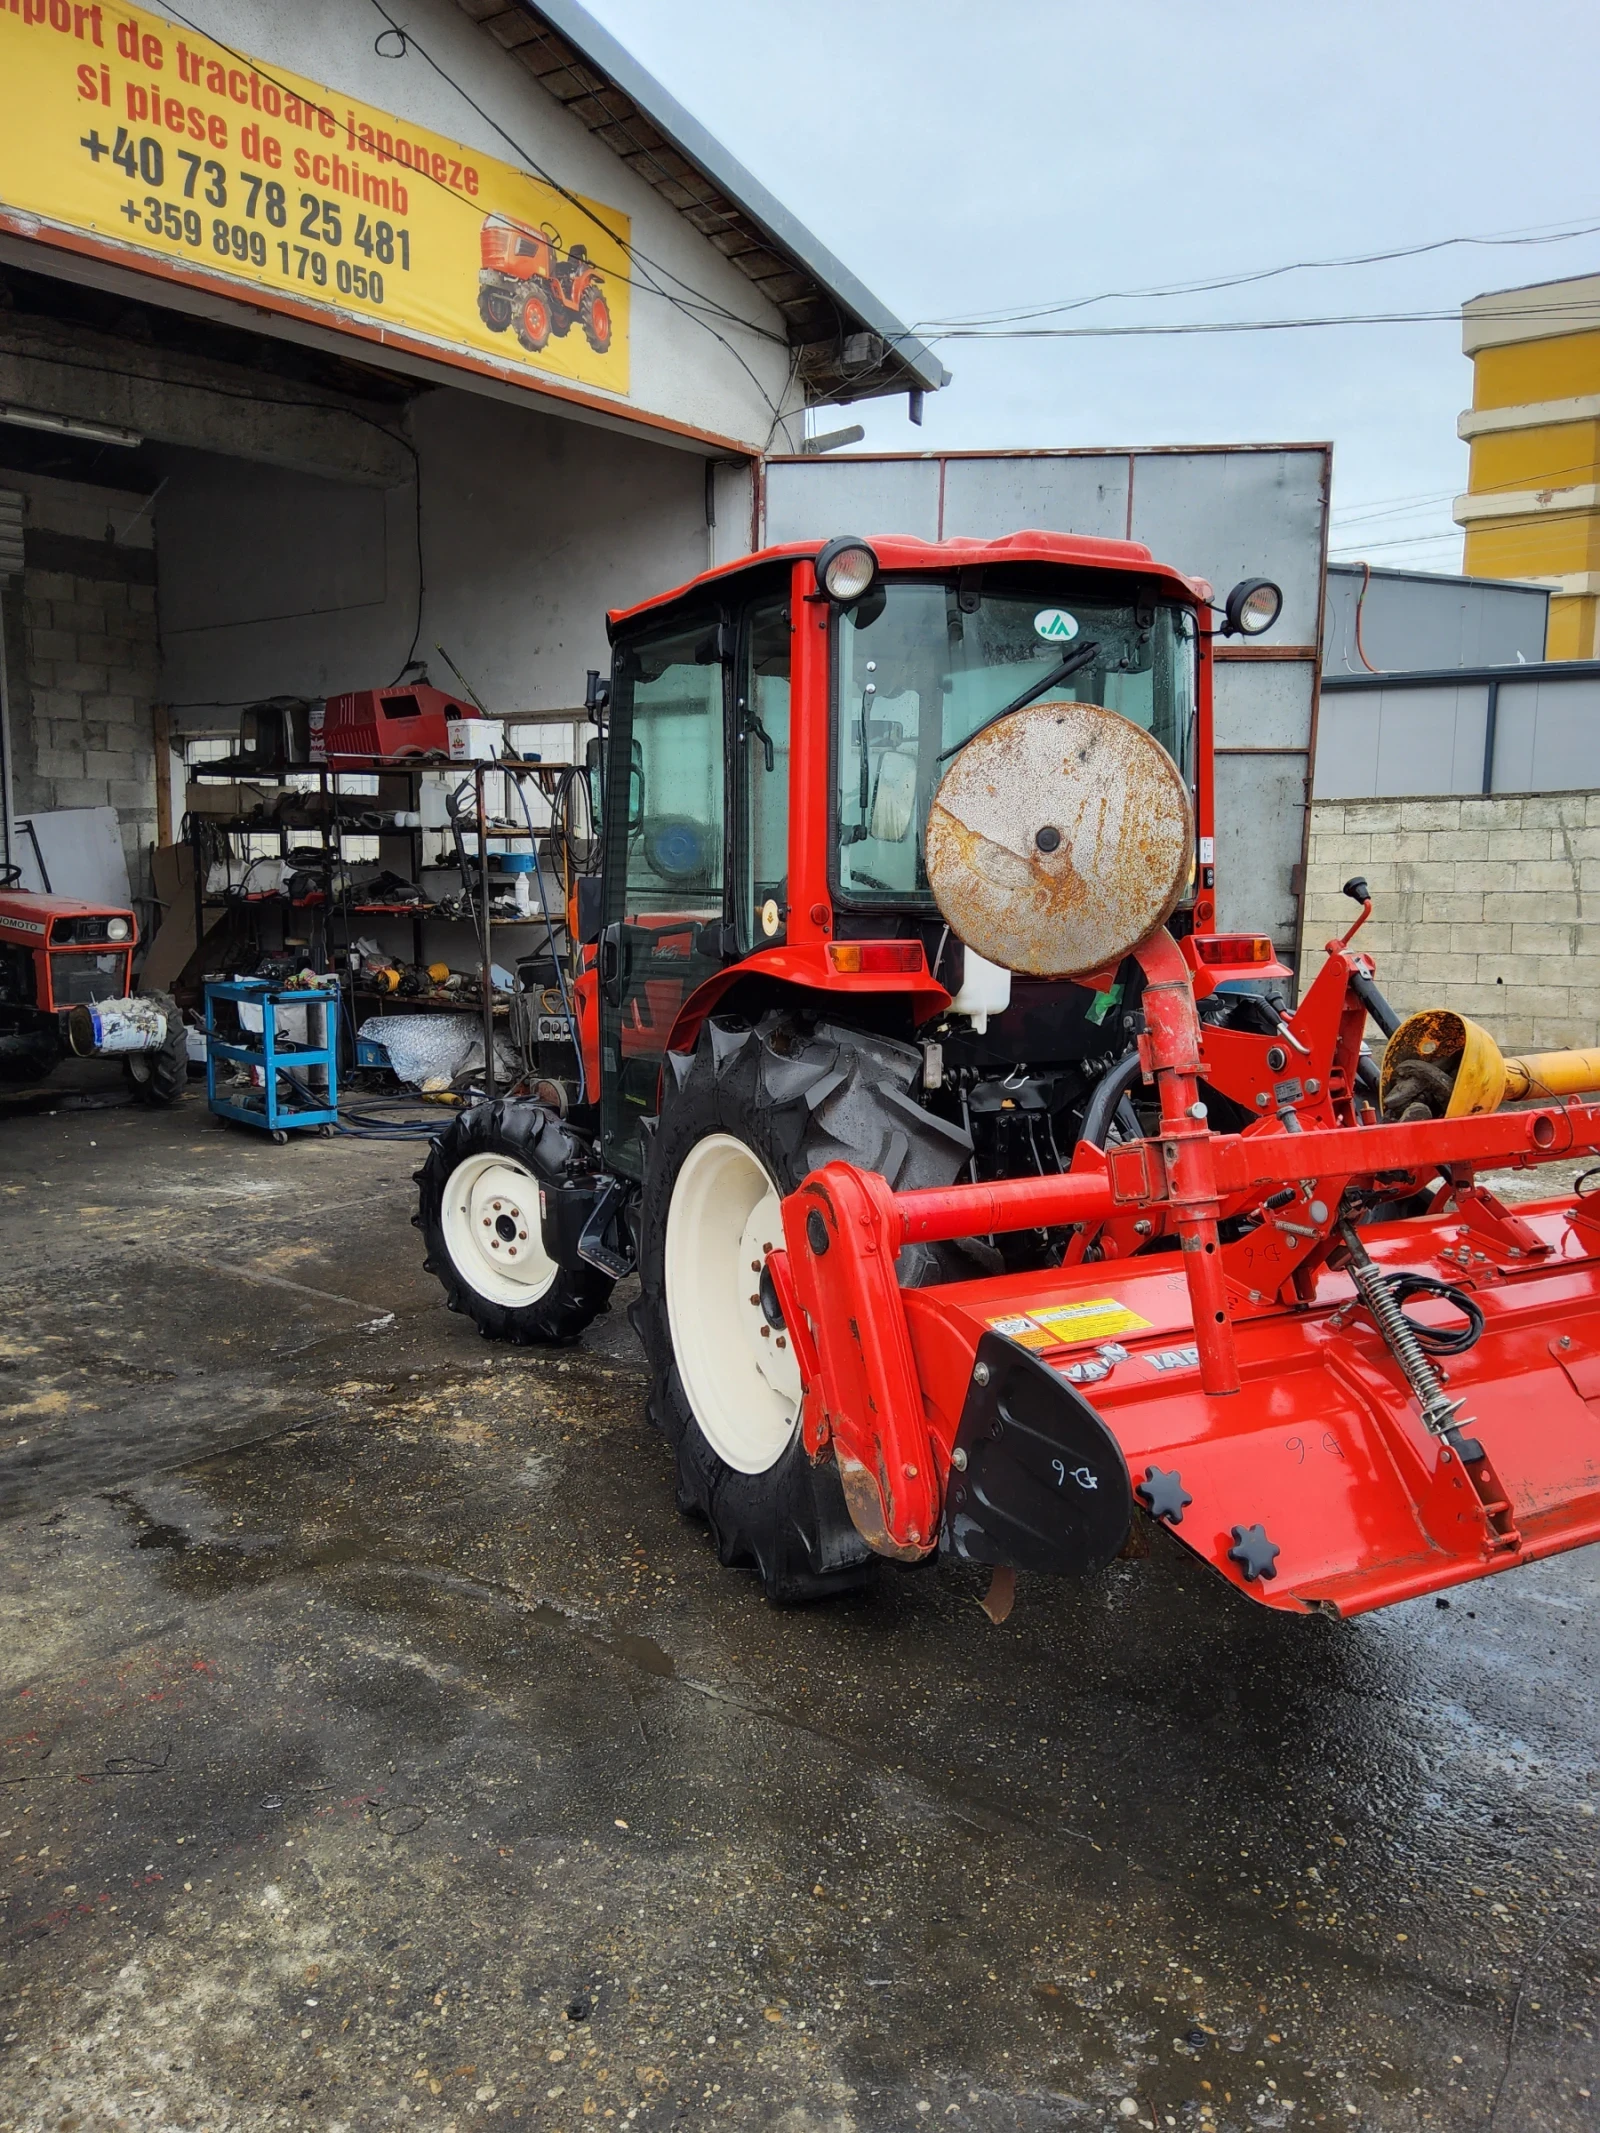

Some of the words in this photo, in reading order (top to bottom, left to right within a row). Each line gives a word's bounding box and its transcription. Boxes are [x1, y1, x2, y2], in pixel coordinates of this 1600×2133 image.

[0, 0, 104, 49] port
[117, 19, 163, 70] de
[176, 40, 336, 139] tractoare
[346, 110, 479, 197] japoneze
[77, 63, 111, 107] si
[126, 81, 228, 150] piese
[240, 122, 282, 169] de
[294, 147, 408, 217] schimb
[80, 126, 164, 187] +40
[177, 148, 227, 209] 73
[240, 171, 287, 228] 78
[300, 193, 342, 247] 25
[354, 213, 410, 272] 481
[120, 196, 202, 247] +359
[212, 219, 267, 267] 899
[277, 240, 328, 287] 179
[336, 259, 384, 304] 050
